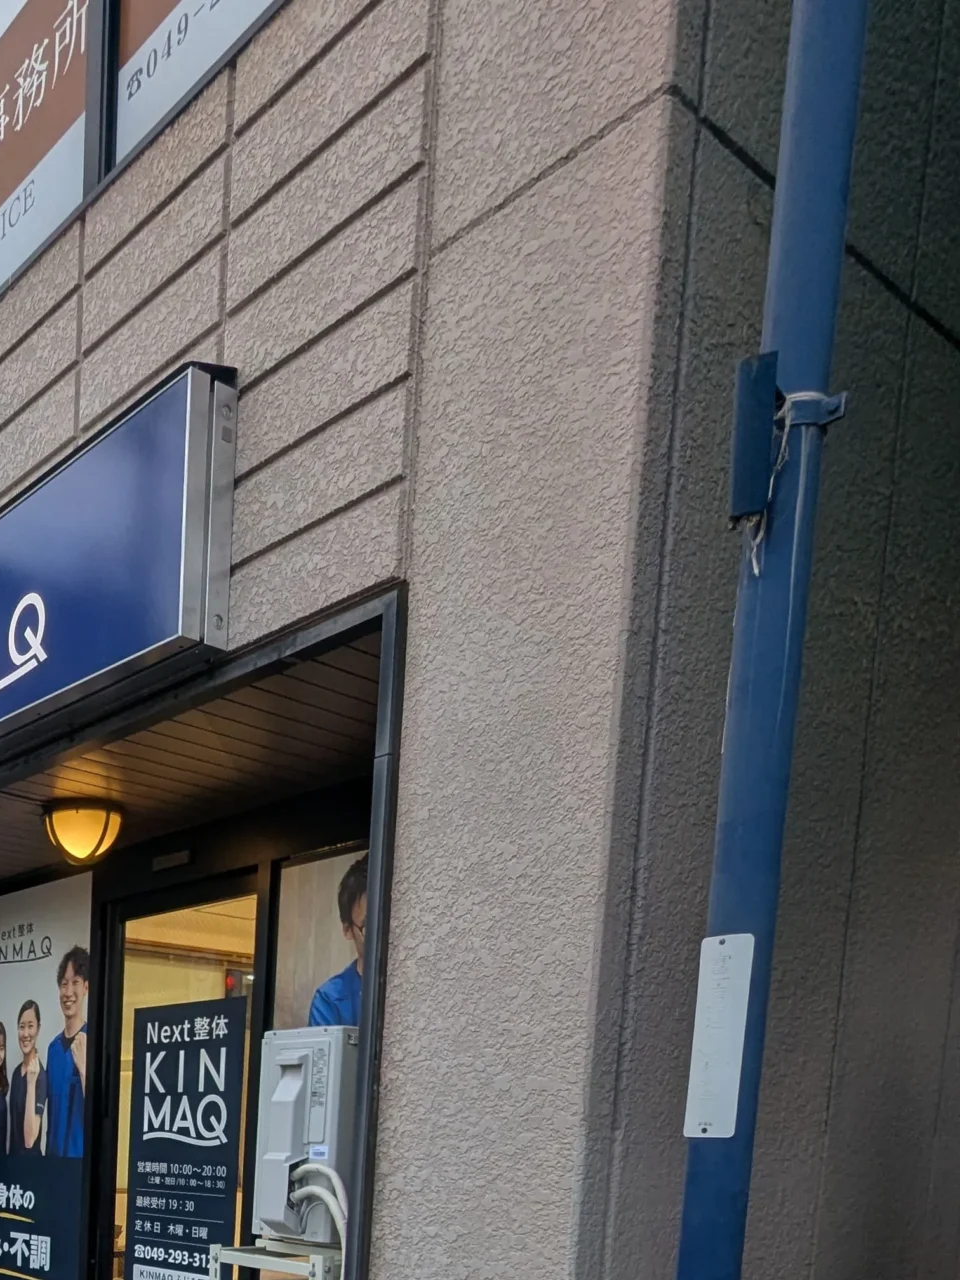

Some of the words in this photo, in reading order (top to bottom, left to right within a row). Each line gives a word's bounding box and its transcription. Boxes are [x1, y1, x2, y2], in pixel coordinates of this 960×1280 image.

[146, 1014, 229, 1045] Next整体
[144, 1046, 227, 1094] KIN
[143, 1094, 228, 1144] MAQ
[137, 1161, 168, 1174] 営業時間
[136, 1196, 166, 1210] 最終受付
[135, 1220, 161, 1233] 定休日
[167, 1223, 208, 1239] 木曜・日曜
